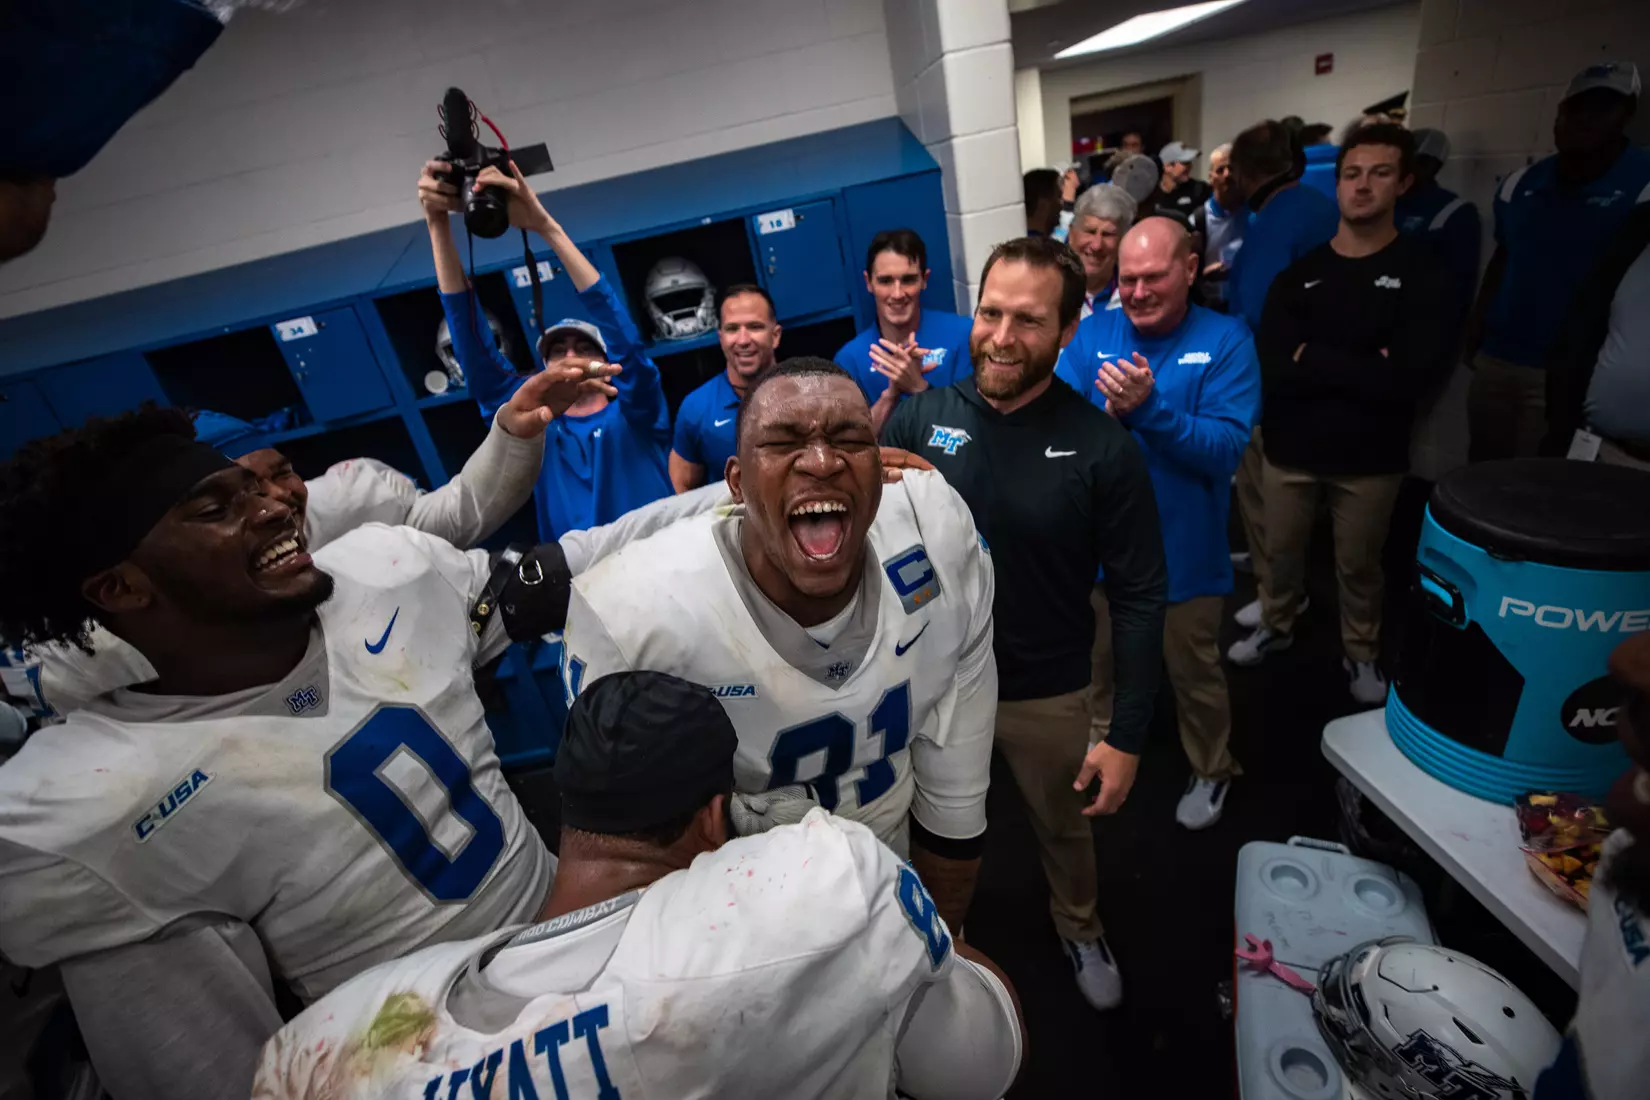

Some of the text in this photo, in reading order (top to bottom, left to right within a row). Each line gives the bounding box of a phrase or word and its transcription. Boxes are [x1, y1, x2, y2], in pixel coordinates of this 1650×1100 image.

[928, 428, 966, 455] MT
[886, 550, 934, 596] C
[286, 685, 323, 715] MT
